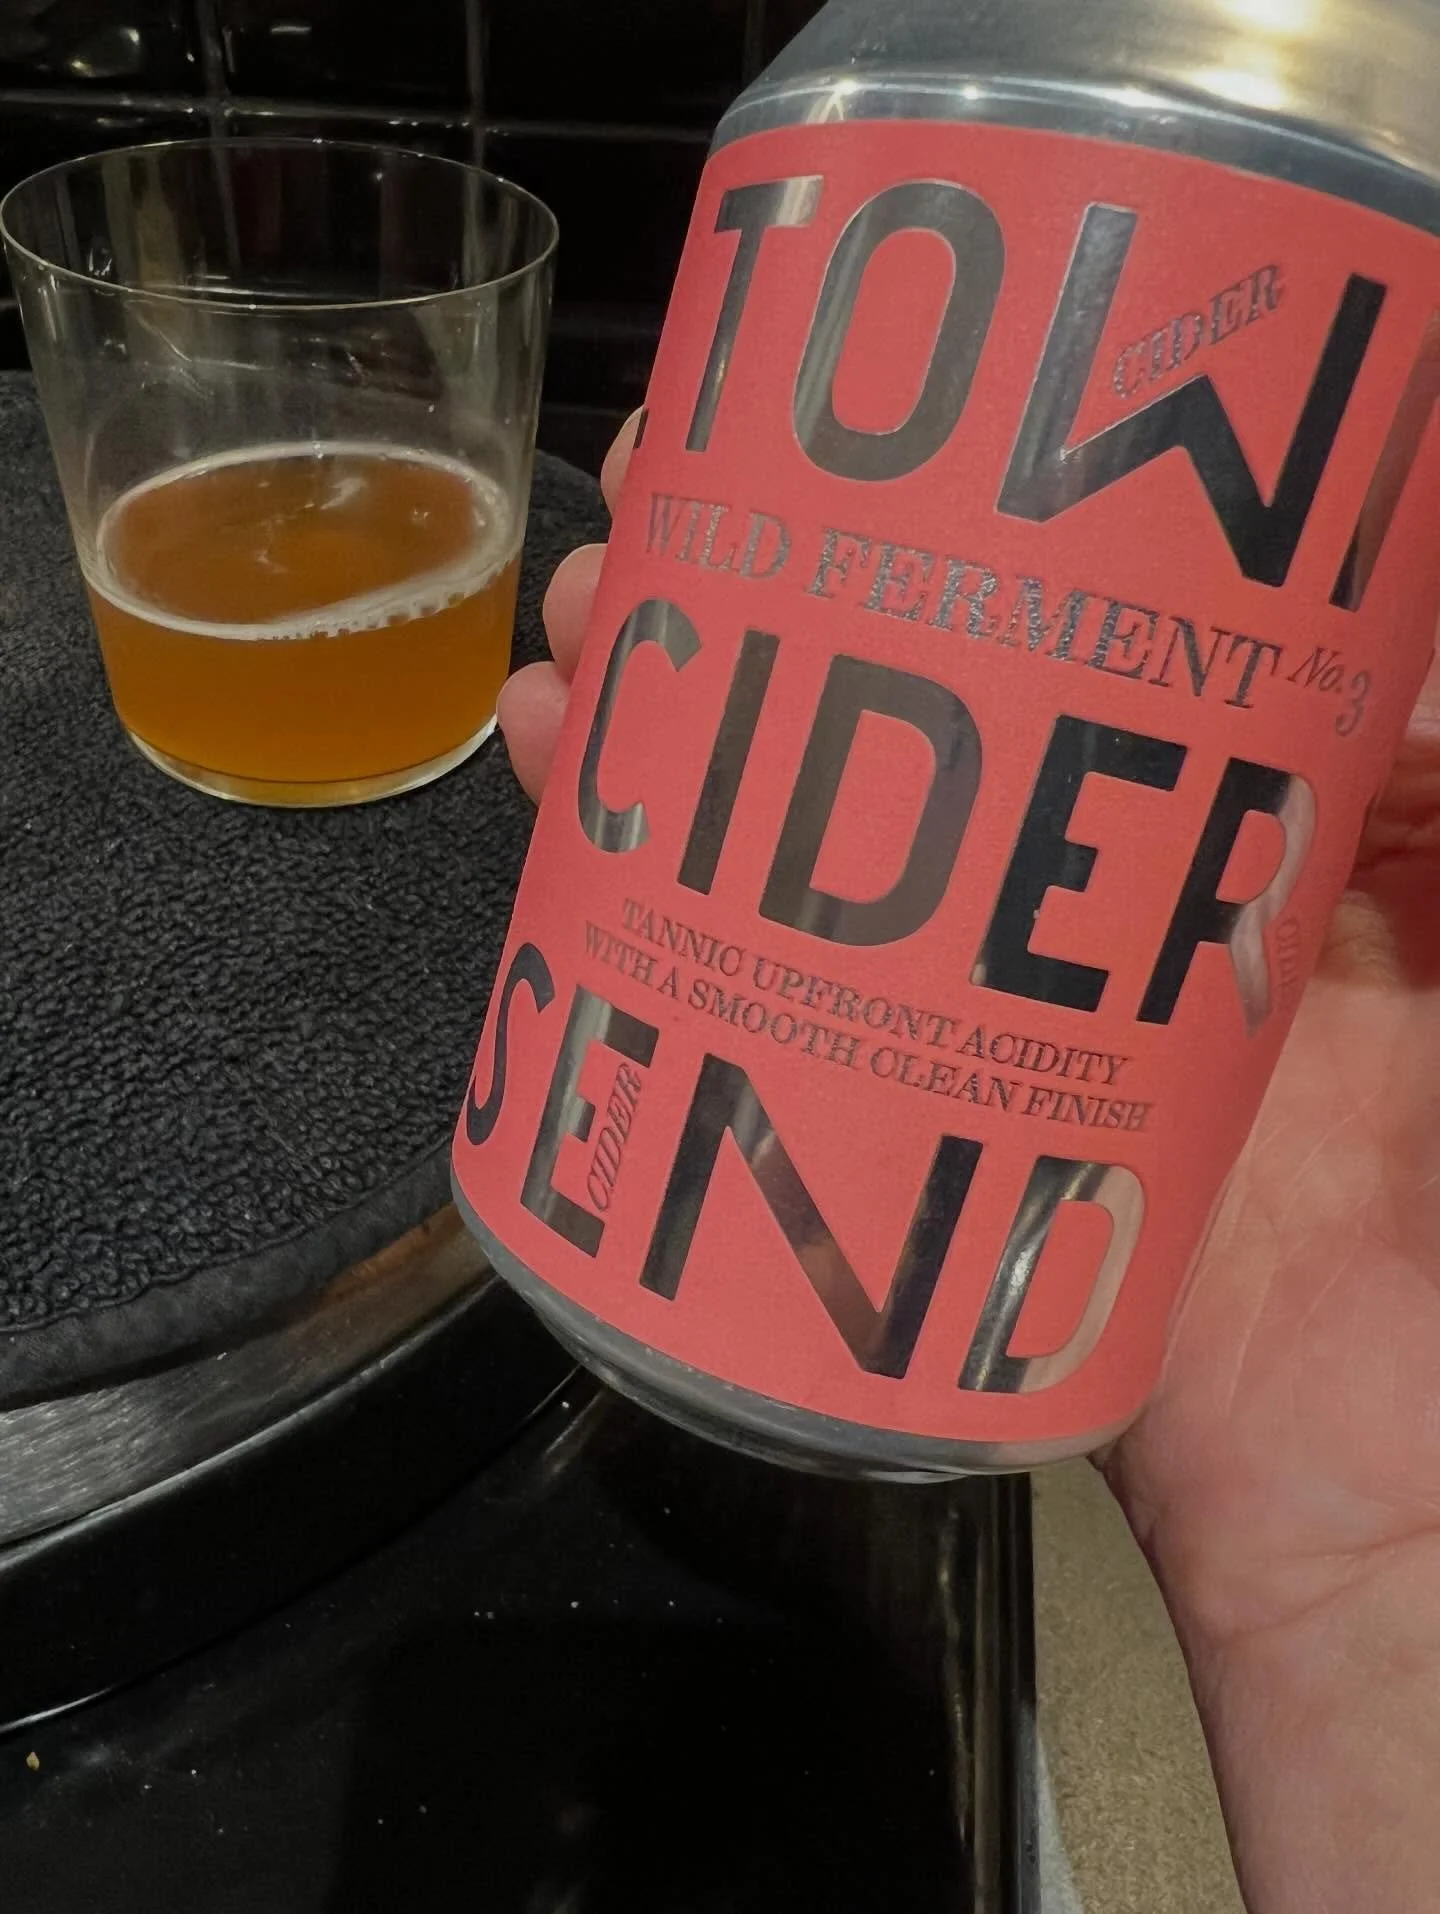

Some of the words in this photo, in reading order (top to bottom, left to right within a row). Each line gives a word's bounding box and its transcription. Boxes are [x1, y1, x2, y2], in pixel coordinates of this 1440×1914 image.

[1112, 264, 1287, 399] CIDER
[645, 492, 793, 581] WILD
[804, 526, 1284, 710] FERMENT
[1285, 646, 1343, 694] No.
[1335, 669, 1371, 738] 3
[576, 597, 1318, 1038] CIDER
[584, 919, 659, 989] WITH
[656, 965, 681, 1001] A
[687, 978, 862, 1071] SMOOTH
[869, 1046, 1024, 1113] CLEAN
[1019, 1084, 1155, 1133] FINISH
[622, 897, 747, 977] TANNIC
[752, 956, 958, 1049] UPFRONT
[955, 1023, 1129, 1086] ACIDITY
[465, 941, 1147, 1394] SEND
[586, 1062, 643, 1211] CIDER
